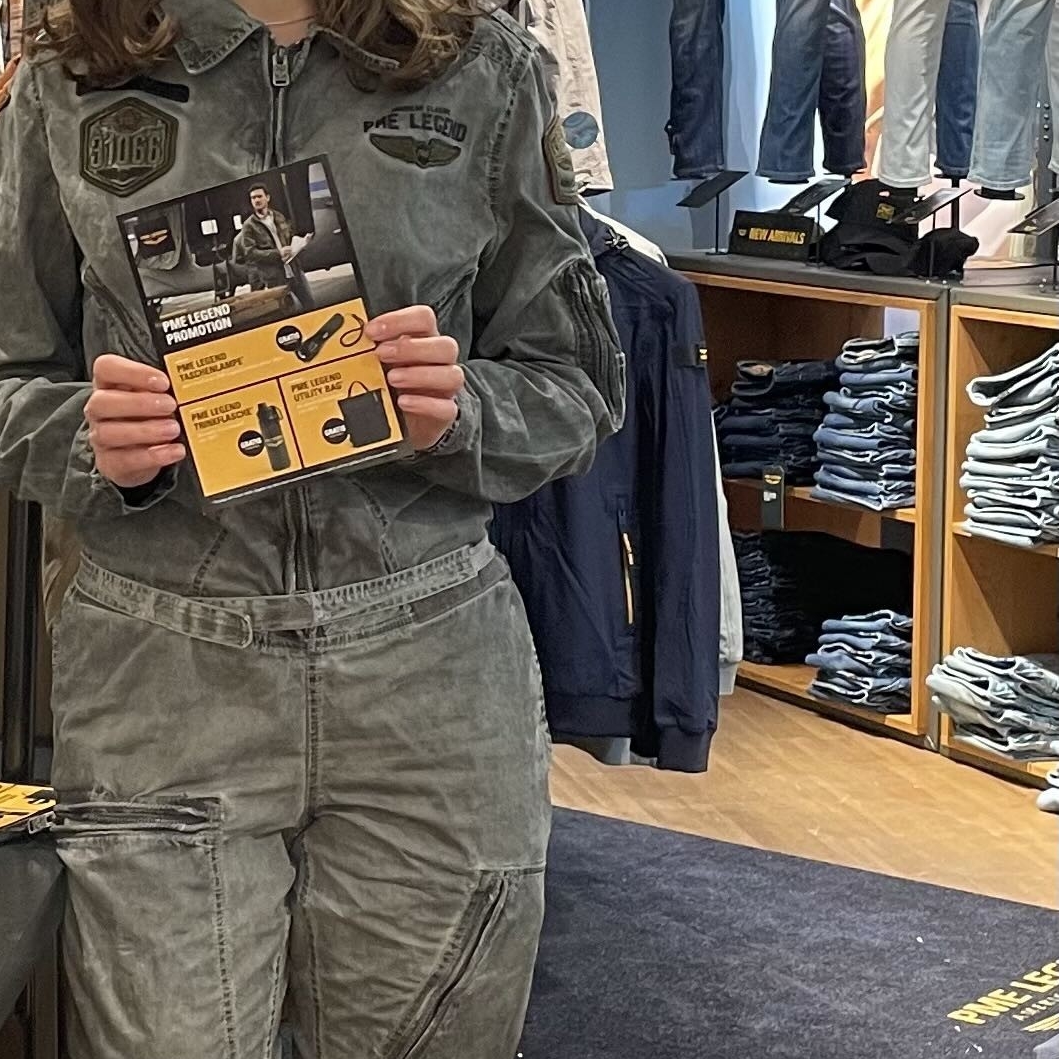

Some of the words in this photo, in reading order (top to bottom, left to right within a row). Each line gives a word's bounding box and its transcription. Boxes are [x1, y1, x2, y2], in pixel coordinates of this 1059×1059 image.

[748, 227, 769, 241] NEW
[767, 229, 806, 245] ARRIVALS
[161, 316, 189, 333] PME
[188, 303, 231, 324] LEGEND
[165, 316, 233, 346] PROMOTION
[946, 989, 1033, 1025] PME
